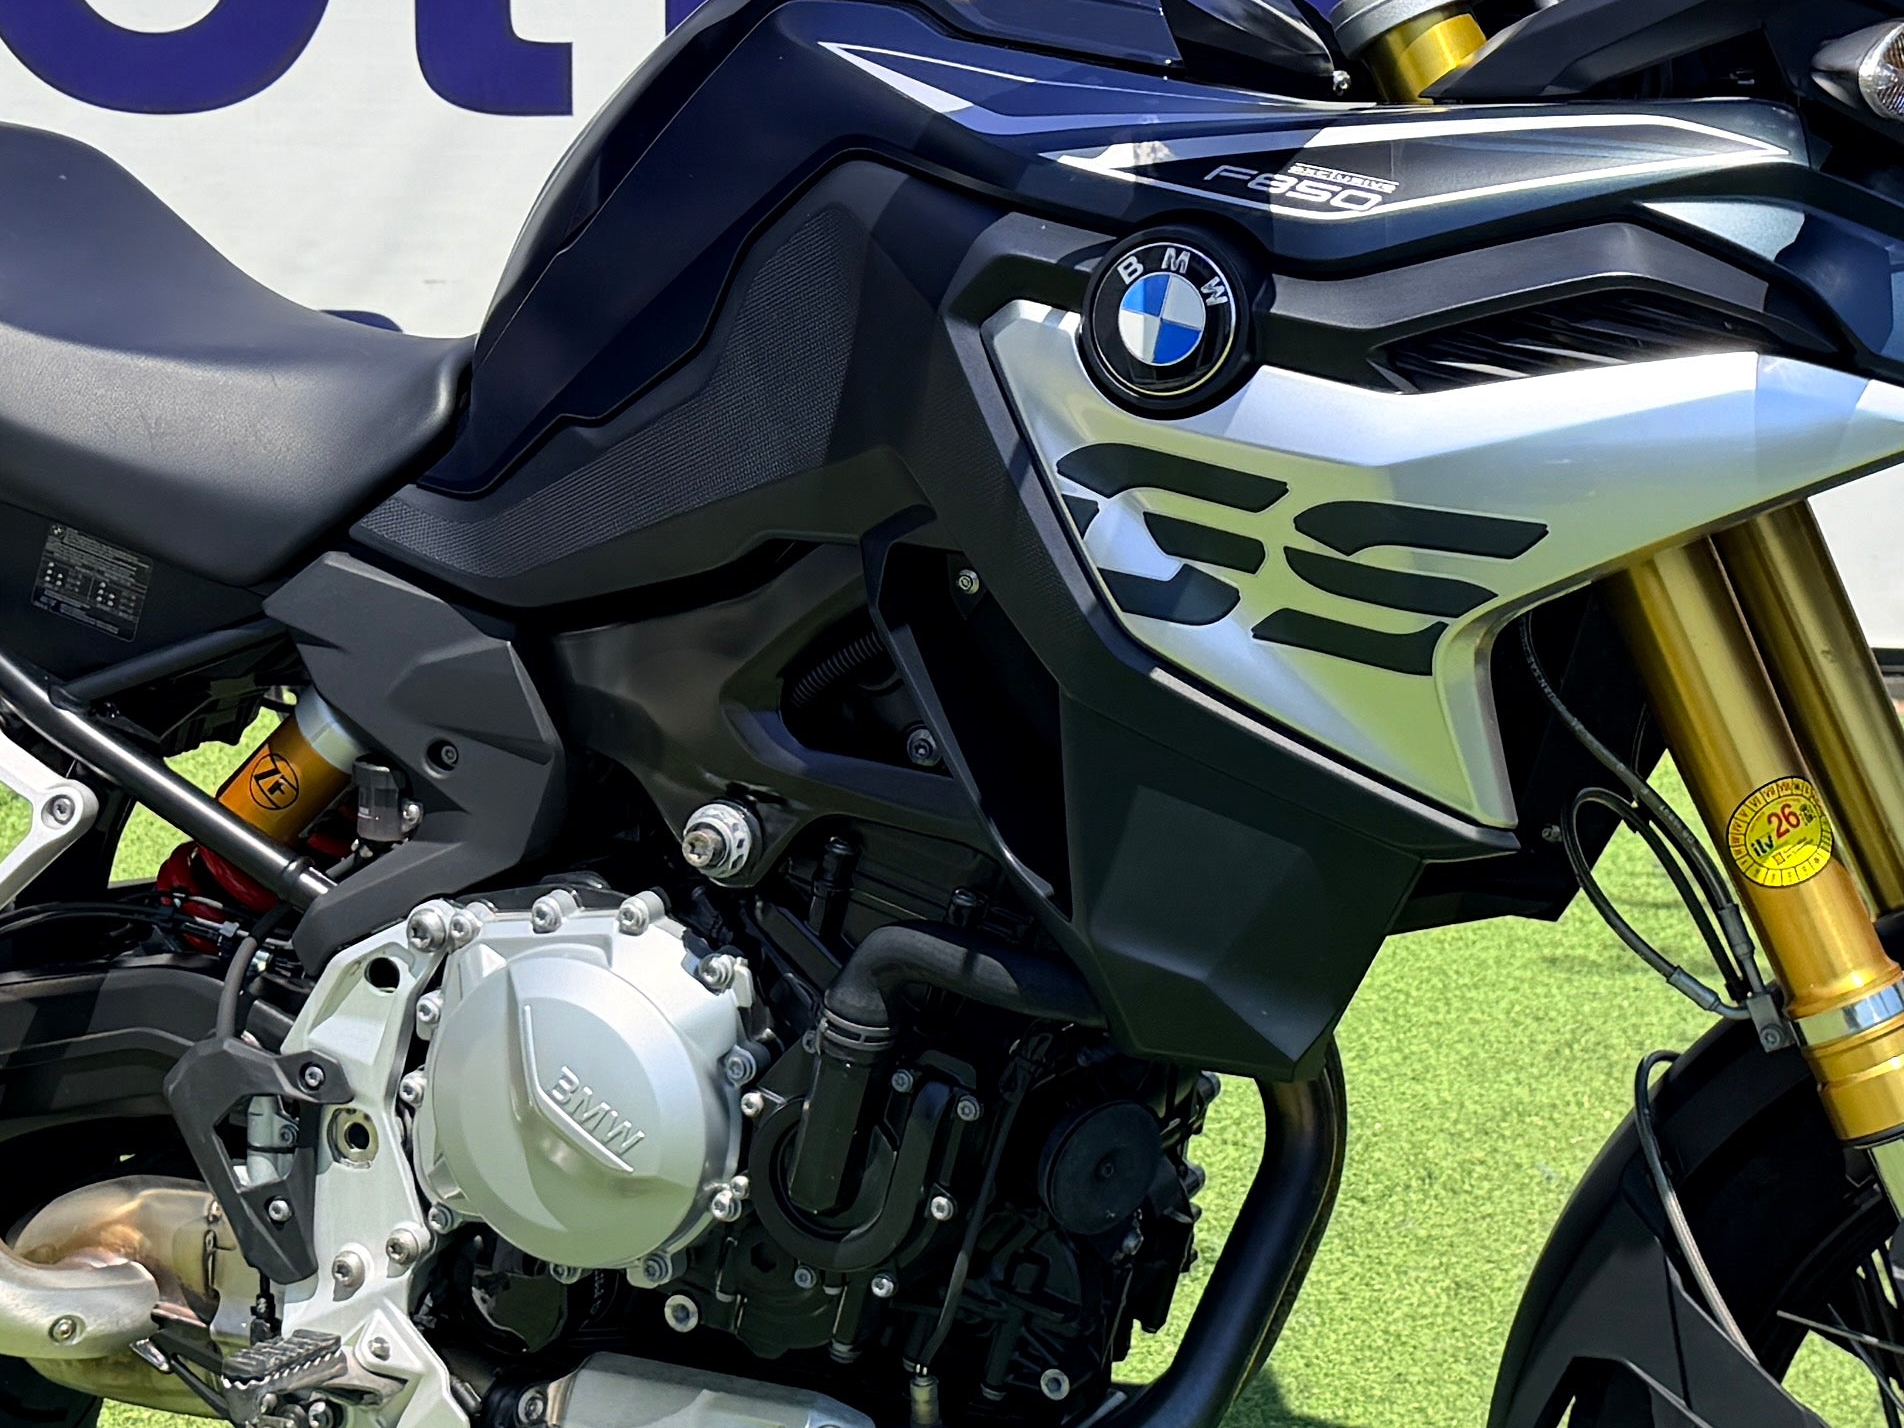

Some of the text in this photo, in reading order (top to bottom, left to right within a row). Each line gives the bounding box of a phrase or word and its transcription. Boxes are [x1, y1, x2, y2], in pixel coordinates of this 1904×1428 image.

[1116, 247, 1228, 307] BMW
[1056, 442, 1550, 677] GS
[1767, 802, 1801, 840] 26
[551, 1065, 646, 1157] BMW
